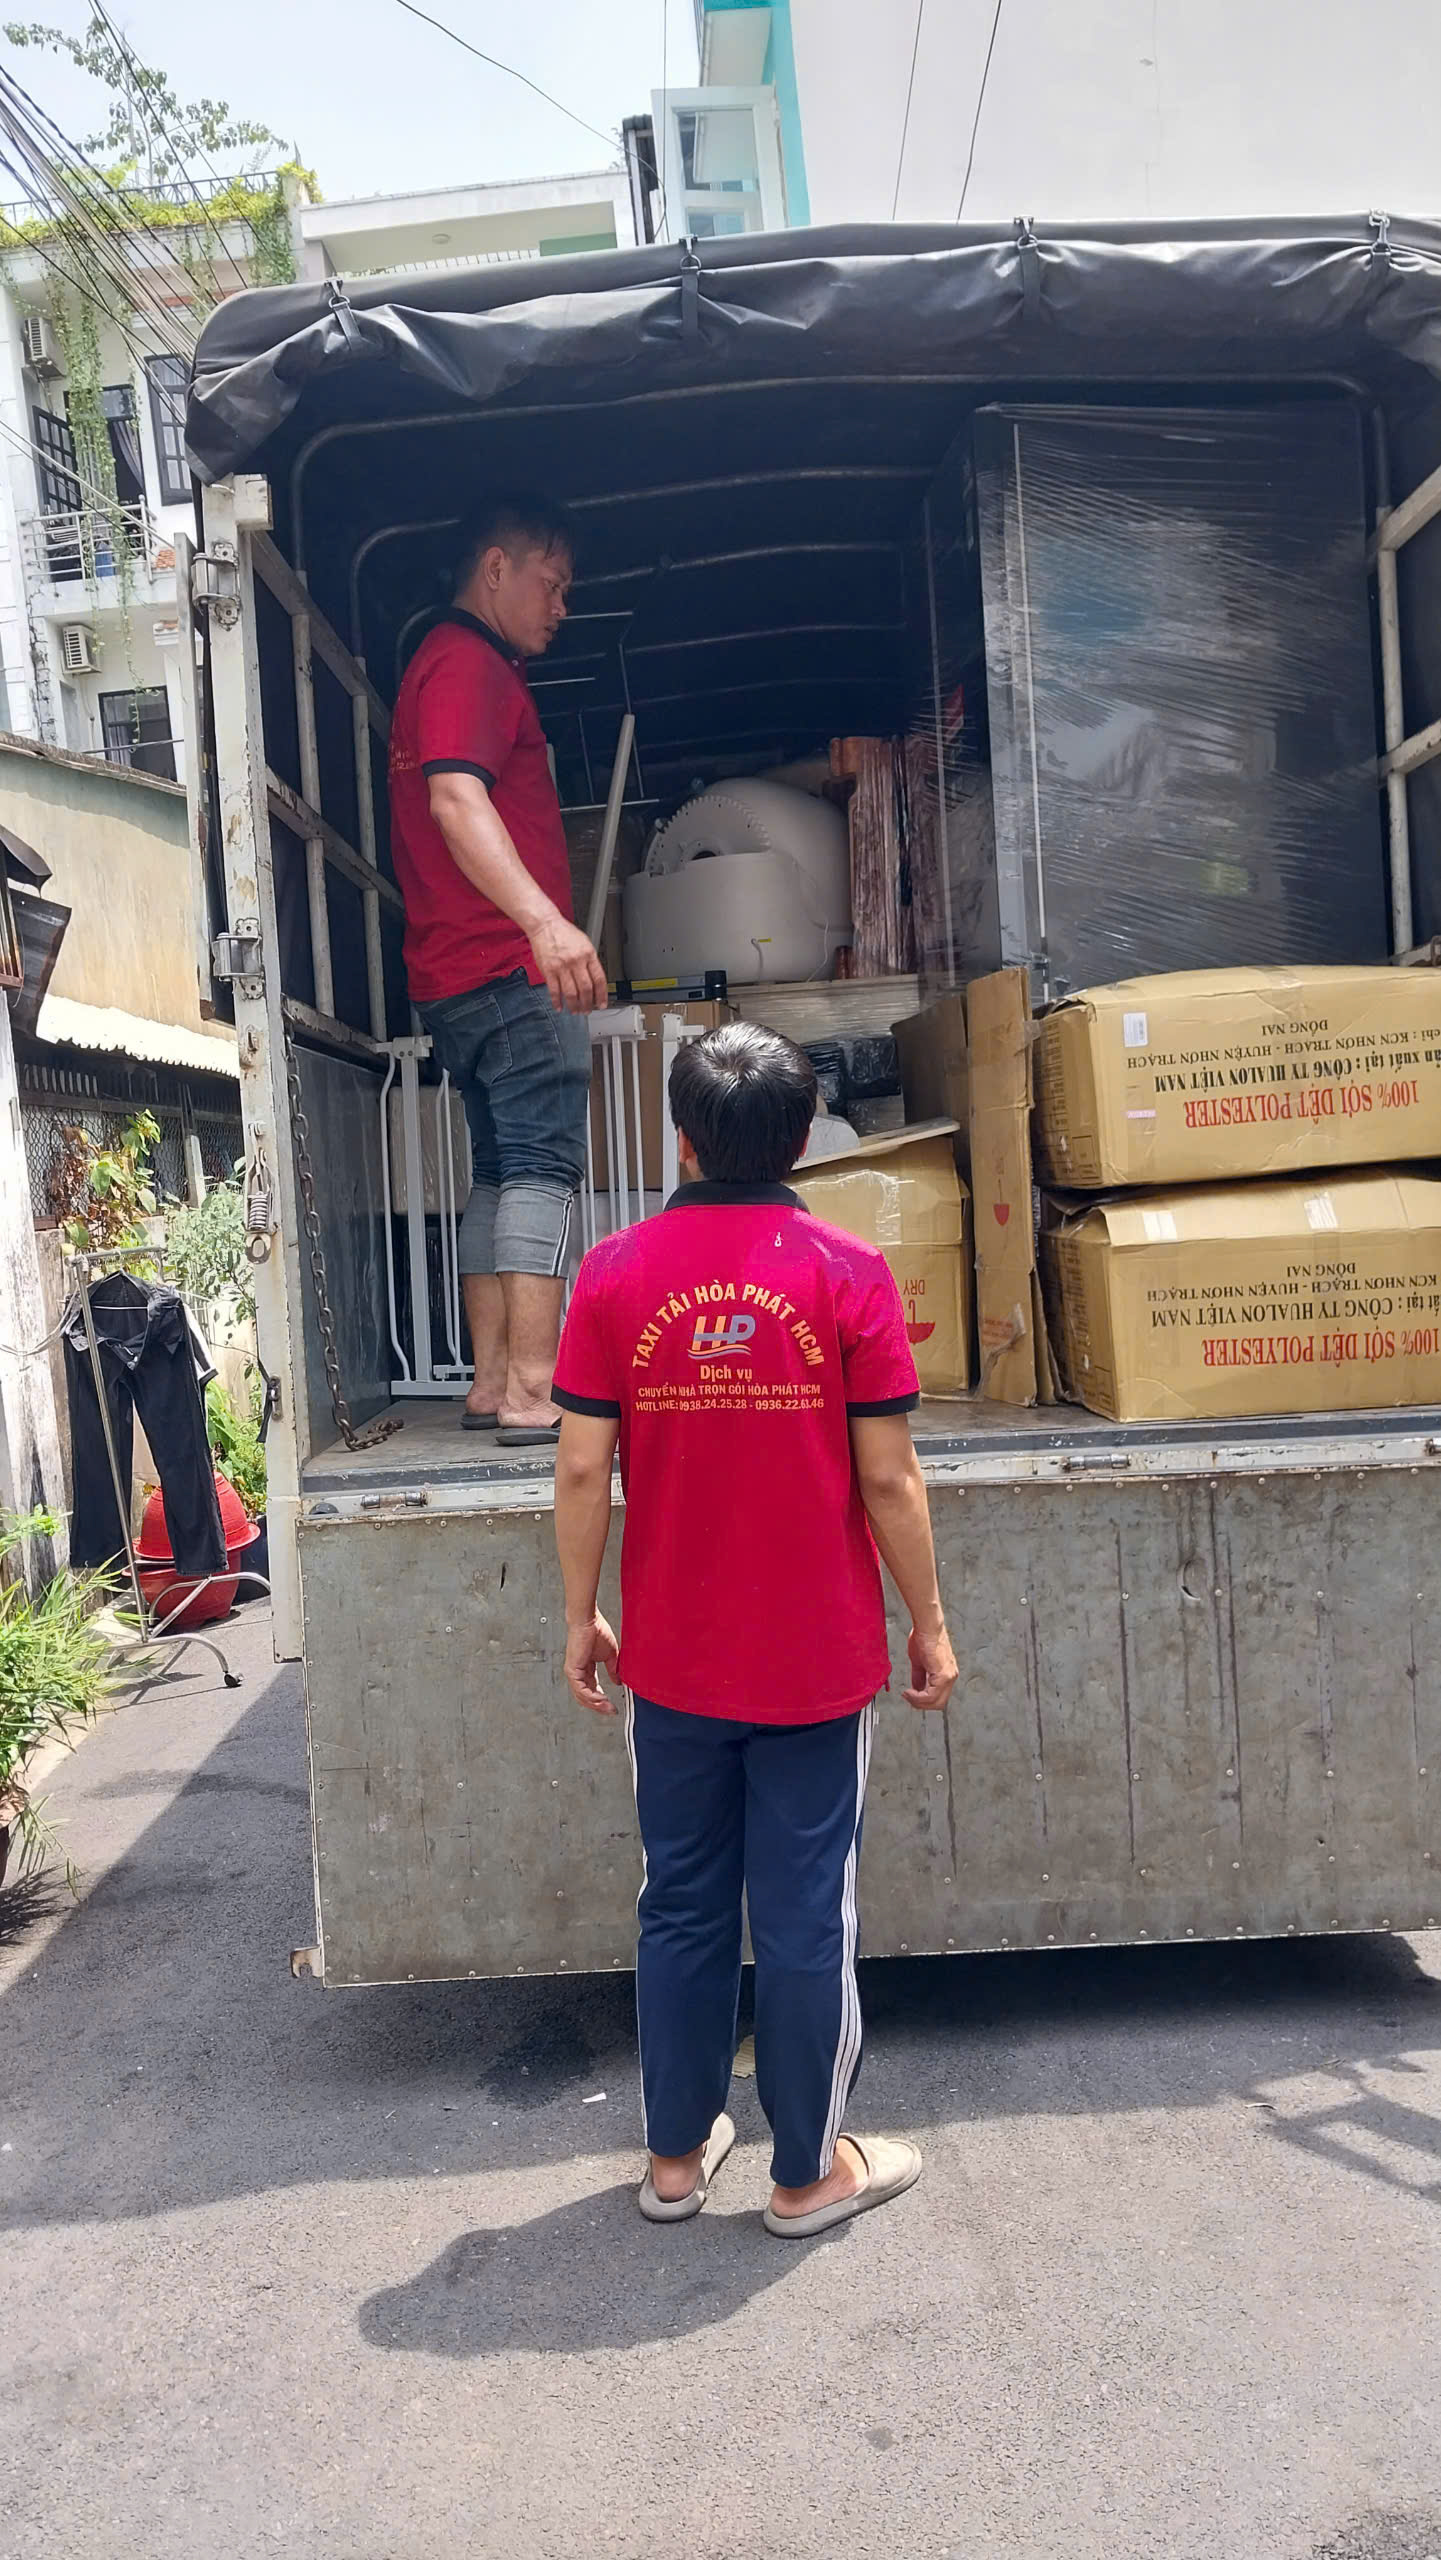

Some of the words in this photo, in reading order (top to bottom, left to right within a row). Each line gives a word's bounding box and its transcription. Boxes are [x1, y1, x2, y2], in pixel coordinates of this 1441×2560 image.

[1262, 1024, 1285, 1036] NAI
[1380, 1032, 1408, 1044] KCN
[1336, 1035, 1375, 1050] NHƠN
[1128, 1054, 1176, 1068] TRẠCH
[1180, 1050, 1219, 1065] NHƠN
[1224, 1045, 1272, 1061] HUYỆN
[1365, 1050, 1384, 1072] tại
[1389, 1051, 1420, 1074] xuất
[1229, 1064, 1286, 1086] HUALON
[1290, 1062, 1310, 1080] TY
[1313, 1058, 1352, 1080] CÔNG
[1154, 1073, 1186, 1093] NAM
[1190, 1067, 1224, 1093] VIỆT
[1296, 1083, 1334, 1124] DỆT
[1340, 1080, 1373, 1118] SỢI
[1377, 1080, 1419, 1108] 100%
[1184, 1091, 1292, 1129] POLYESTER
[1287, 1265, 1311, 1278] NAI
[1409, 1274, 1437, 1288] KCN
[903, 1280, 925, 1295] DRY
[1248, 1282, 1298, 1297] HUYỆN
[1312, 1278, 1361, 1293] TRẠCH
[1364, 1276, 1405, 1290] NHƠN
[1147, 1286, 1198, 1302] TRẠCH
[1201, 1286, 1244, 1300] NHƠN
[1407, 1292, 1424, 1313] tại
[1152, 1309, 1191, 1328] NAM
[1196, 1303, 1236, 1328] VIỆT
[1241, 1303, 1313, 1323] HUALON
[1318, 1301, 1340, 1319] TY
[1344, 1298, 1393, 1320] CÔNG
[632, 1322, 662, 1368] TAXI
[656, 1292, 692, 1324] TẢI
[694, 1280, 736, 1304] HÒA
[742, 1284, 796, 1320] PHÁT
[790, 1320, 824, 1366] HCM
[1201, 1336, 1314, 1367] POLYESTER
[1320, 1327, 1358, 1368] DỆT
[1364, 1325, 1395, 1364] SỢI
[1400, 1328, 1440, 1357] 100%
[700, 1364, 732, 1381] Dịch
[736, 1368, 752, 1382] vụ
[638, 1382, 677, 1398] CHUYỂN
[678, 1384, 696, 1396] NHÀ
[698, 1384, 726, 1398] TRỌN
[728, 1382, 745, 1395] GÓI
[748, 1382, 768, 1396] HÒA
[772, 1382, 799, 1395] PHÁT
[800, 1384, 820, 1395] HCM
